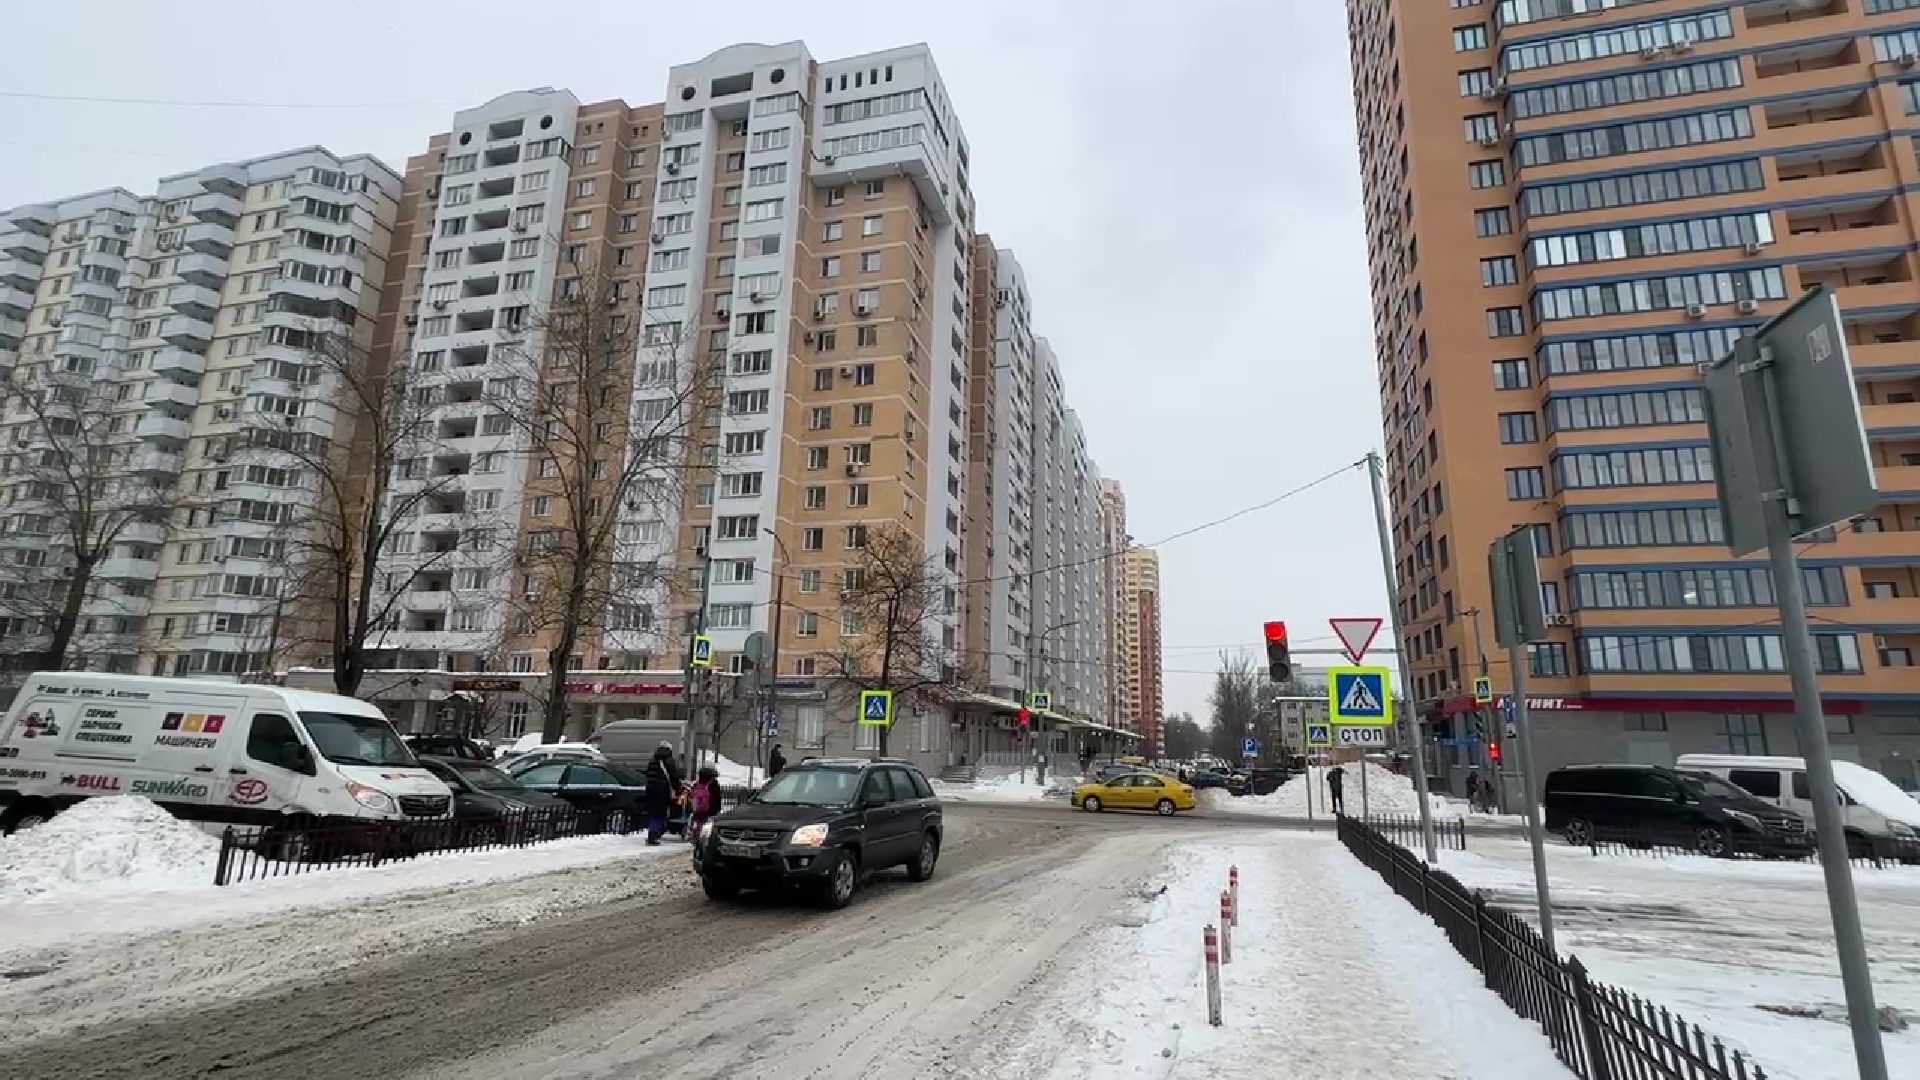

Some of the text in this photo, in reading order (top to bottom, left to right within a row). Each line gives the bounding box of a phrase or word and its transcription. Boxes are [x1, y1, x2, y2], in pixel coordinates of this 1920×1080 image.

[85, 708, 118, 719] СЕРВИС
[80, 720, 123, 730] ЗАПЧАСТИ
[154, 735, 217, 748] МАШИНЕРИ
[1341, 728, 1383, 742] СТОП
[76, 774, 121, 791] BULL
[130, 778, 208, 797] SUNWARD
